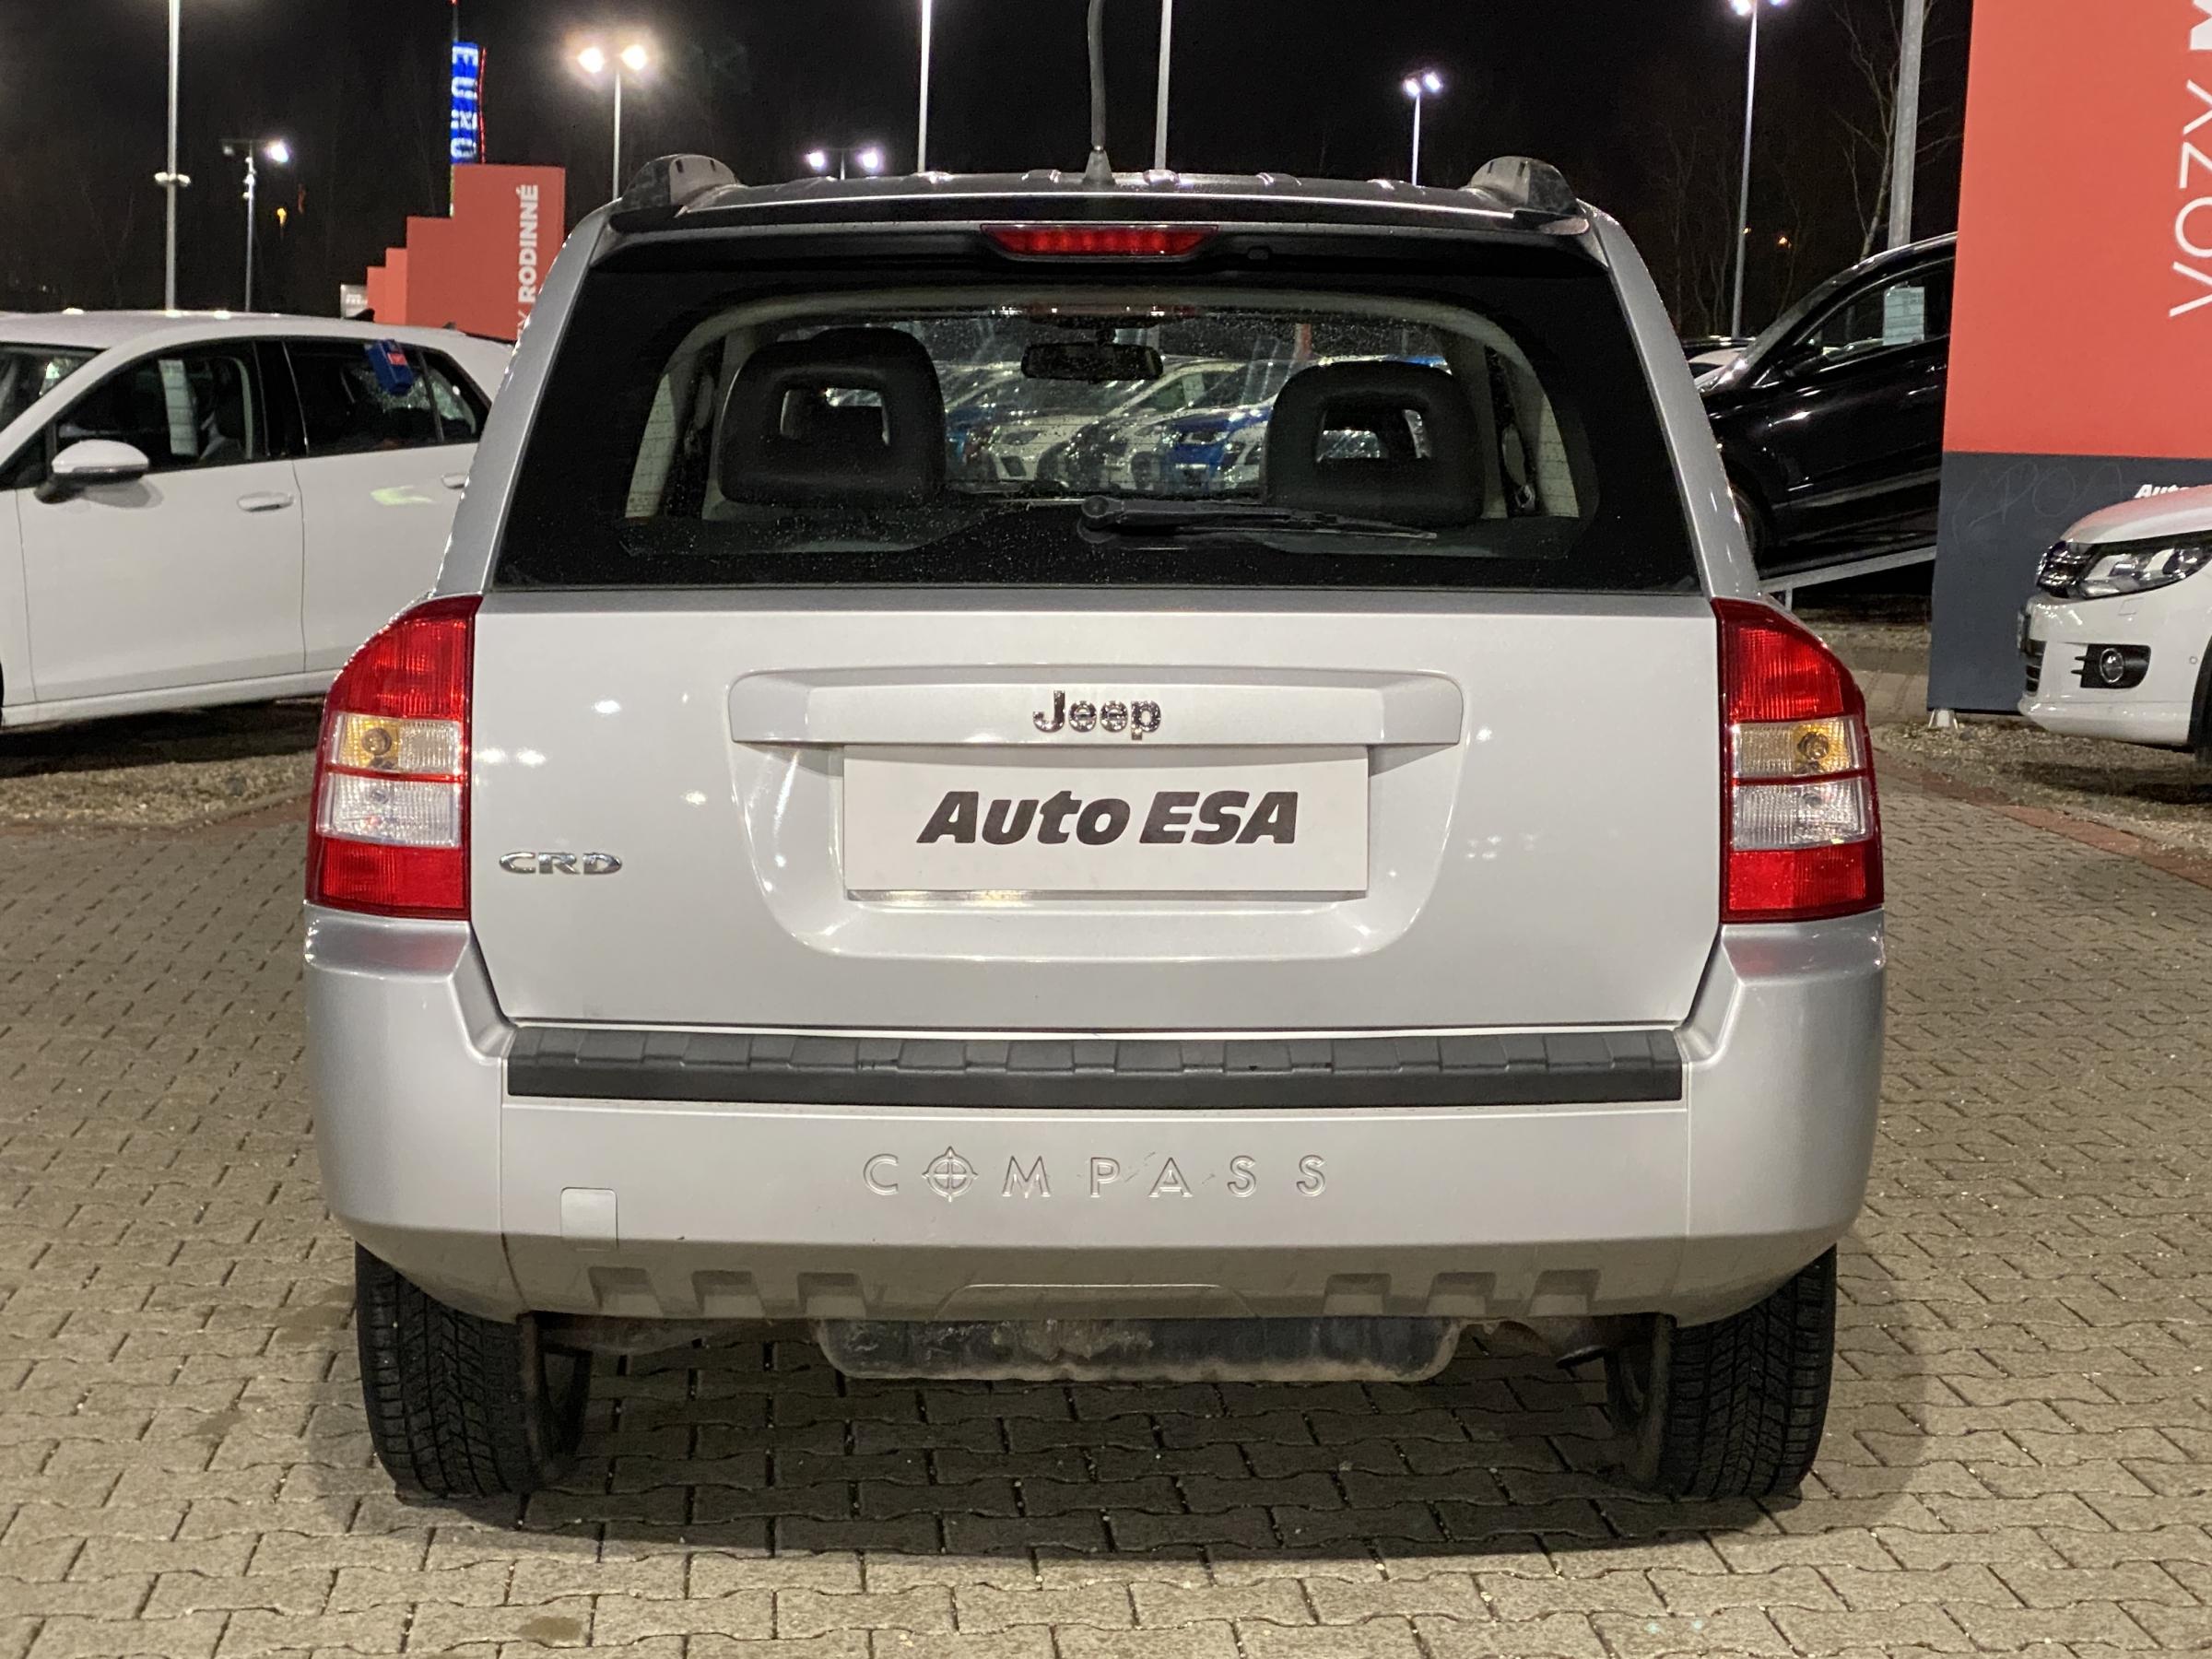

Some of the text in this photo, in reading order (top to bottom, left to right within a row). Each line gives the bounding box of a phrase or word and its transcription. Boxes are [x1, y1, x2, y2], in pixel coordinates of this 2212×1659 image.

[516, 184, 539, 303] RODINNÉ
[1032, 689, 1161, 741] Jeep
[916, 790, 1299, 845] Auto ESA
[499, 851, 623, 876] CRD
